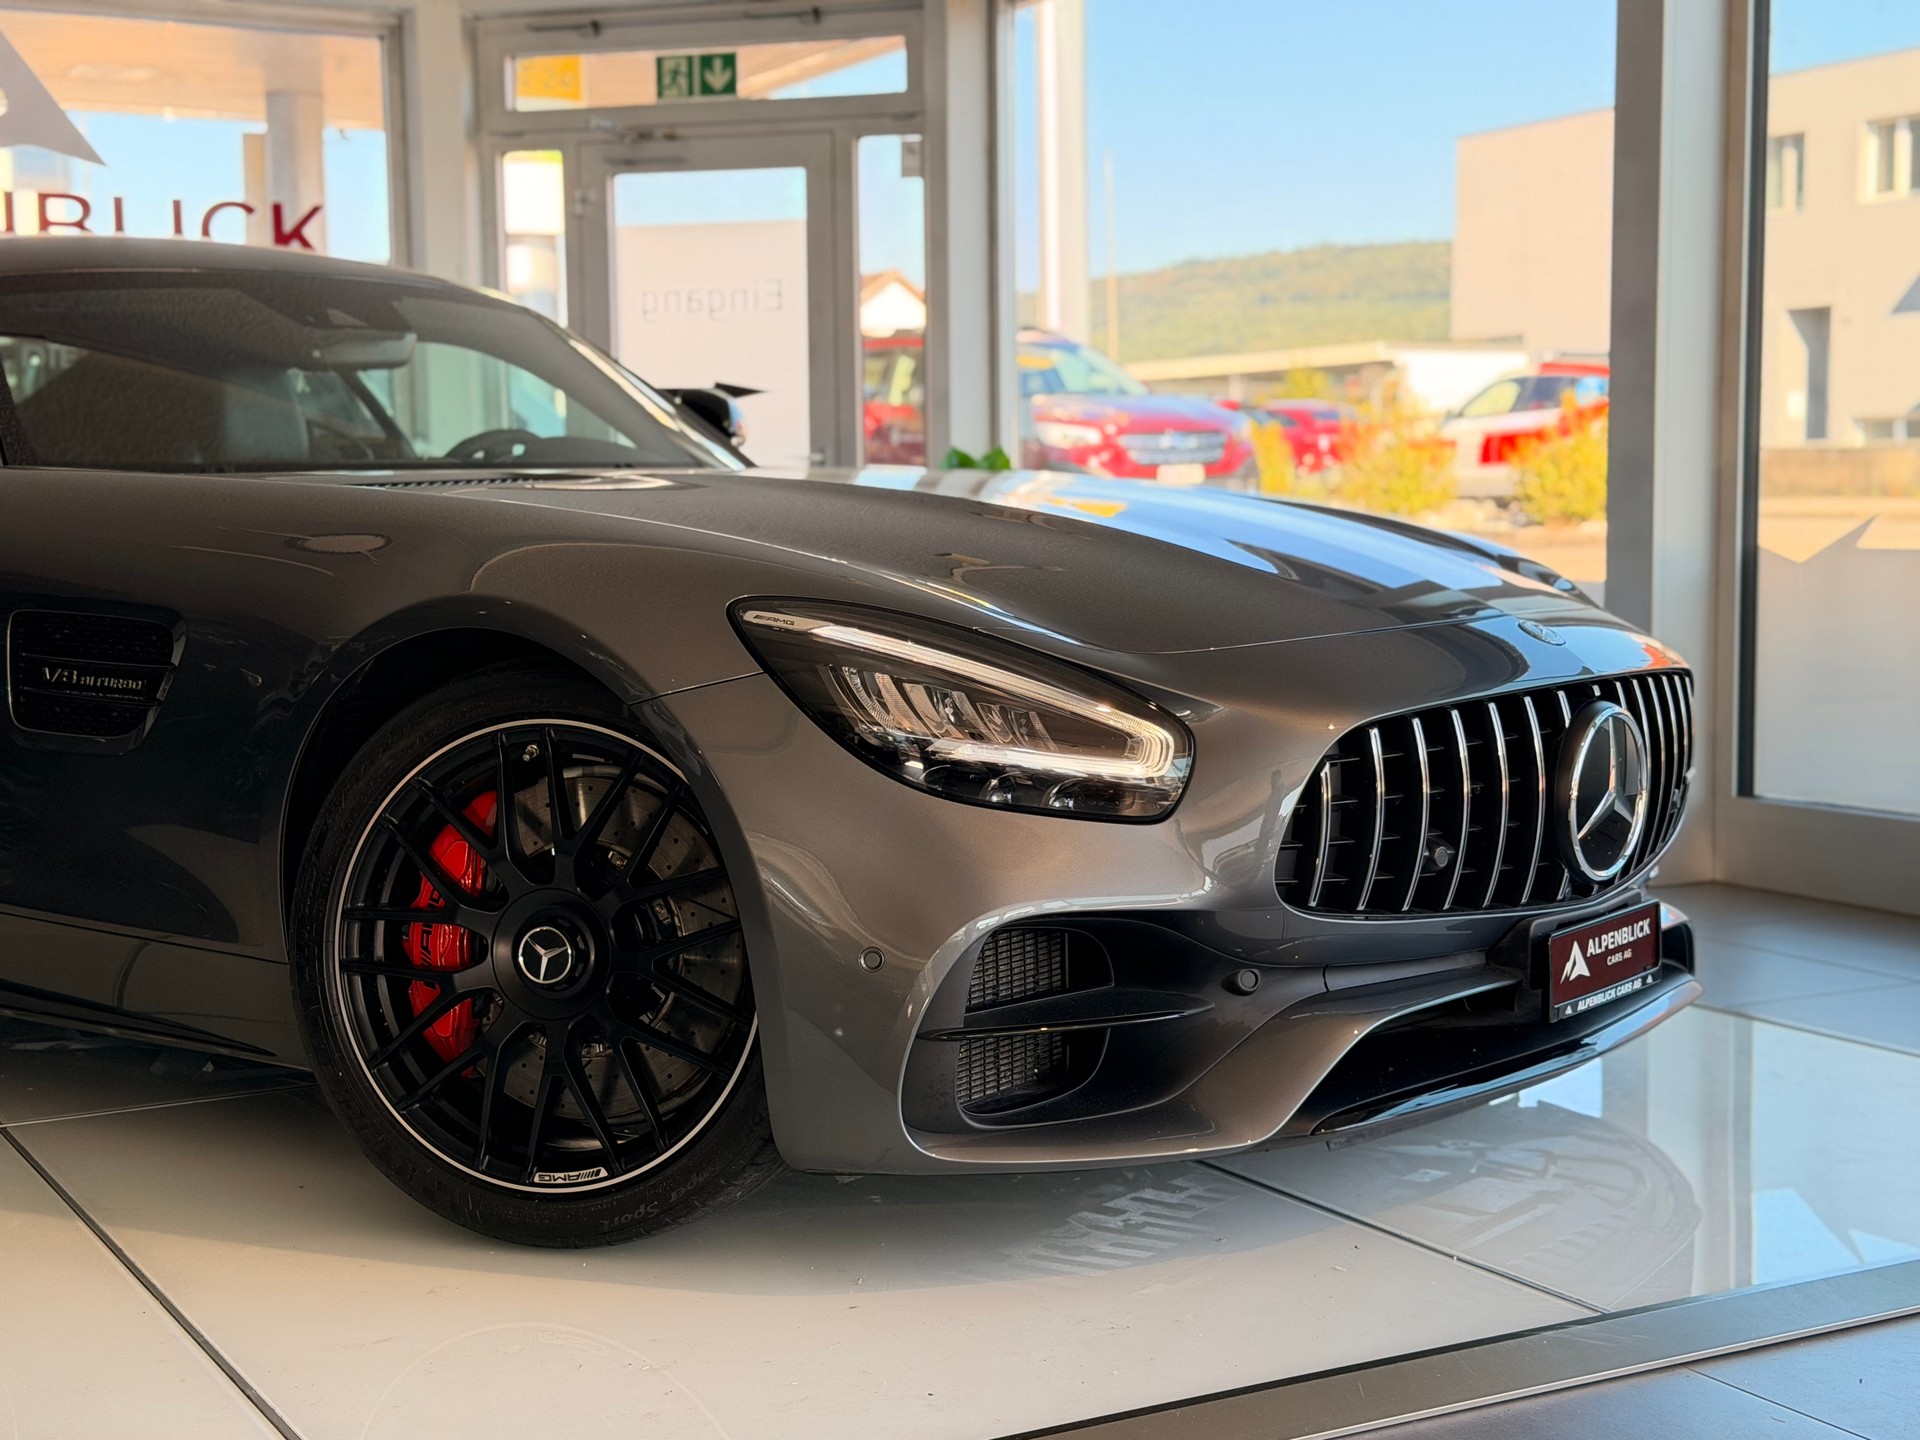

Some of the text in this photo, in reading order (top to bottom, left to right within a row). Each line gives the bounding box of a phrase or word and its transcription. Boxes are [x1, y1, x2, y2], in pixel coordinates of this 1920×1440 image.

[42, 667, 78, 684] V8
[1587, 918, 1651, 957] ALPENBLICK
[1607, 949, 1632, 965] CARS AG
[1577, 978, 1642, 1011] ALPENBLICK CARS AG
[538, 1172, 581, 1183] AMG
[600, 1200, 659, 1231] Sport
